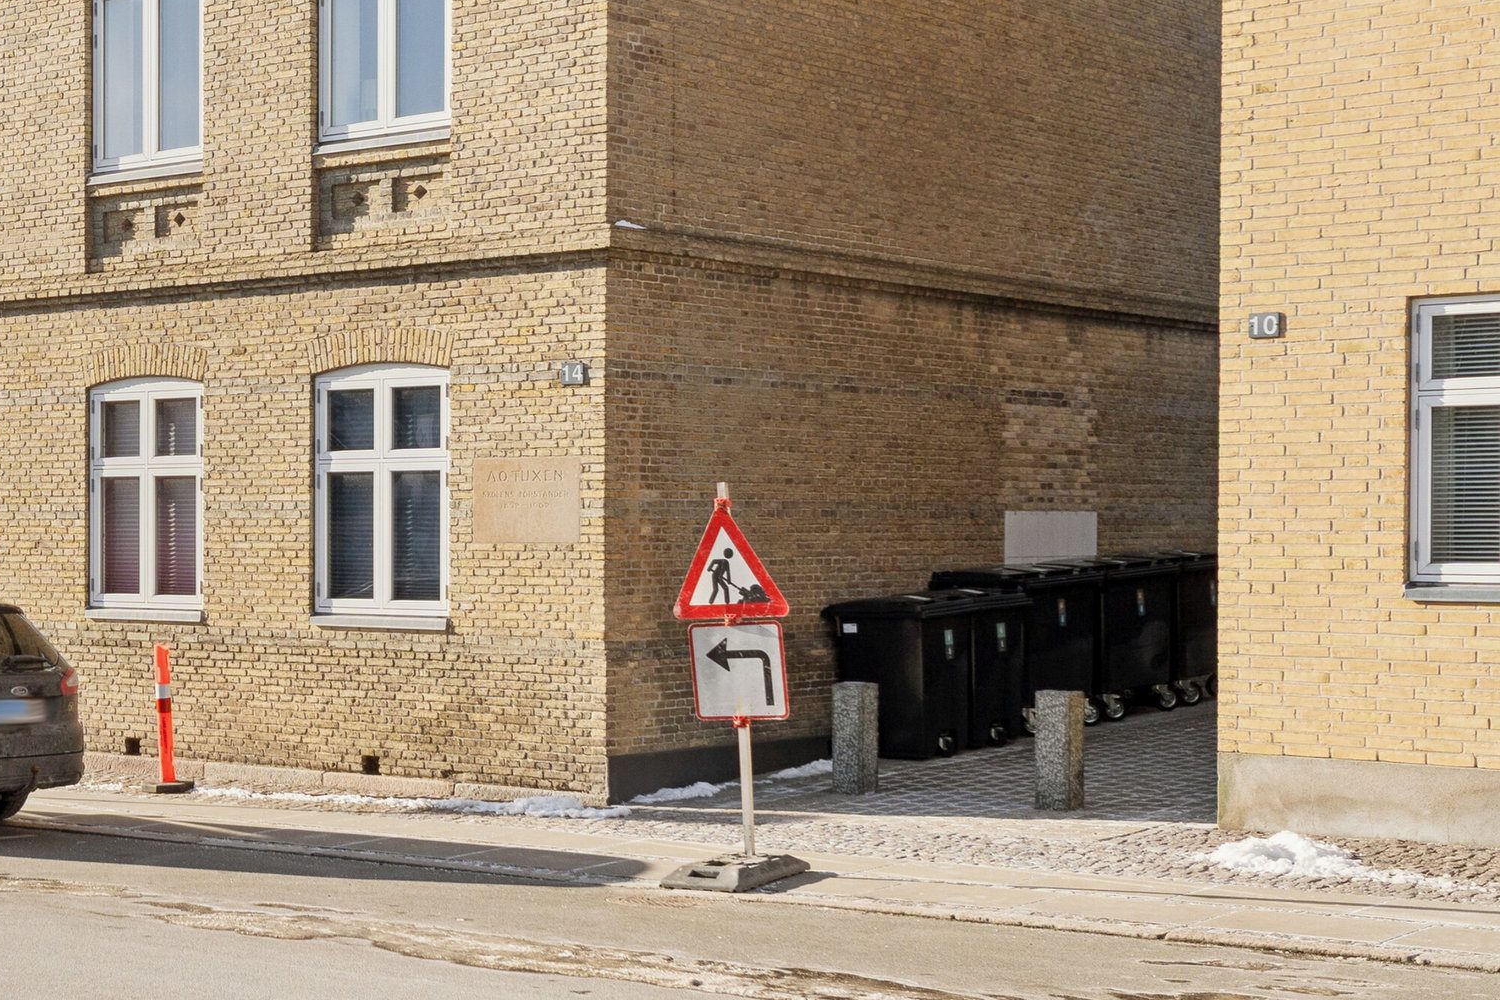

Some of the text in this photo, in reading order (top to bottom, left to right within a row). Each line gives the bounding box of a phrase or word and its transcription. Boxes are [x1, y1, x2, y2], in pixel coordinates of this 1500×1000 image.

[1249, 315, 1278, 336] 10
[562, 364, 583, 382] 14
[511, 470, 564, 482] TUXEN
